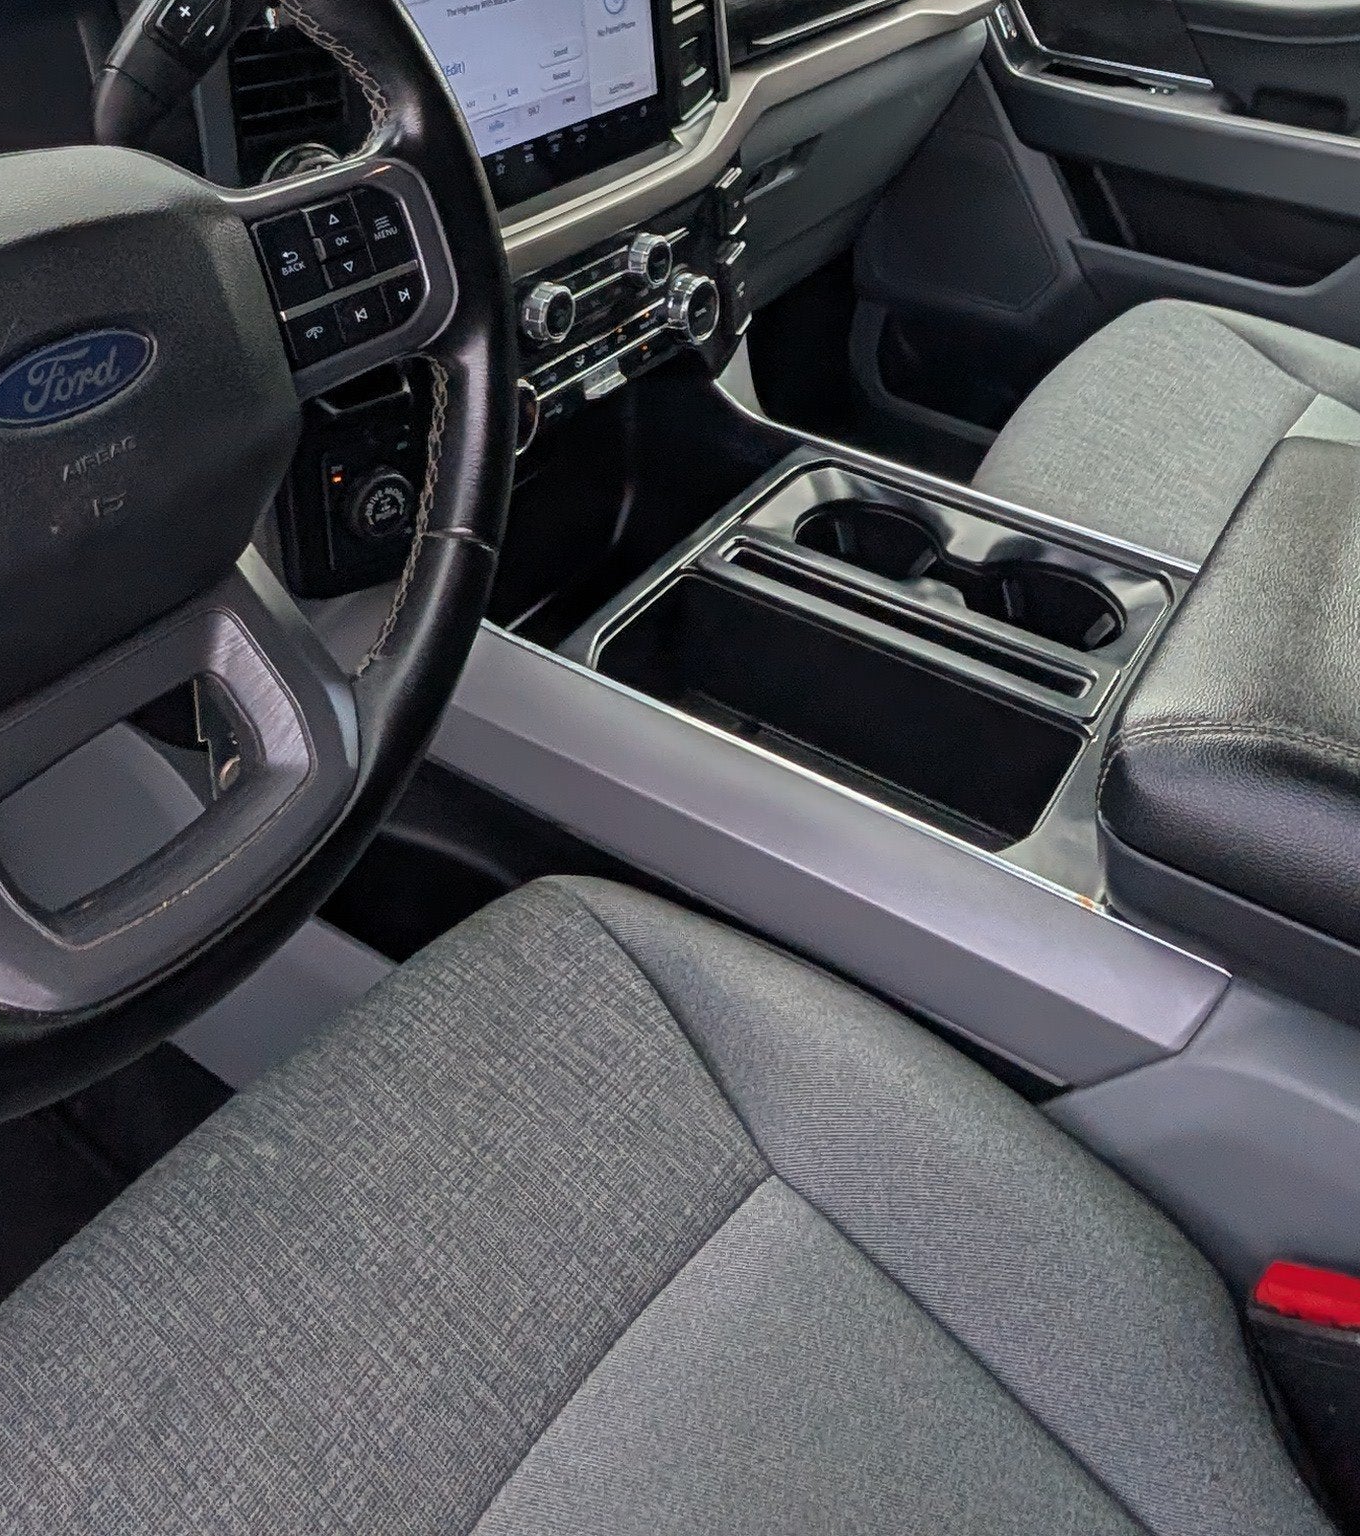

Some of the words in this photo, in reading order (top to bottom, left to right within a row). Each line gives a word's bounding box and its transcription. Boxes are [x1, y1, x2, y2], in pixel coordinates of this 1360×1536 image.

[373, 226, 398, 241] MENU
[335, 236, 349, 247] OK
[281, 261, 306, 276] BACK
[23, 346, 122, 413] Ford
